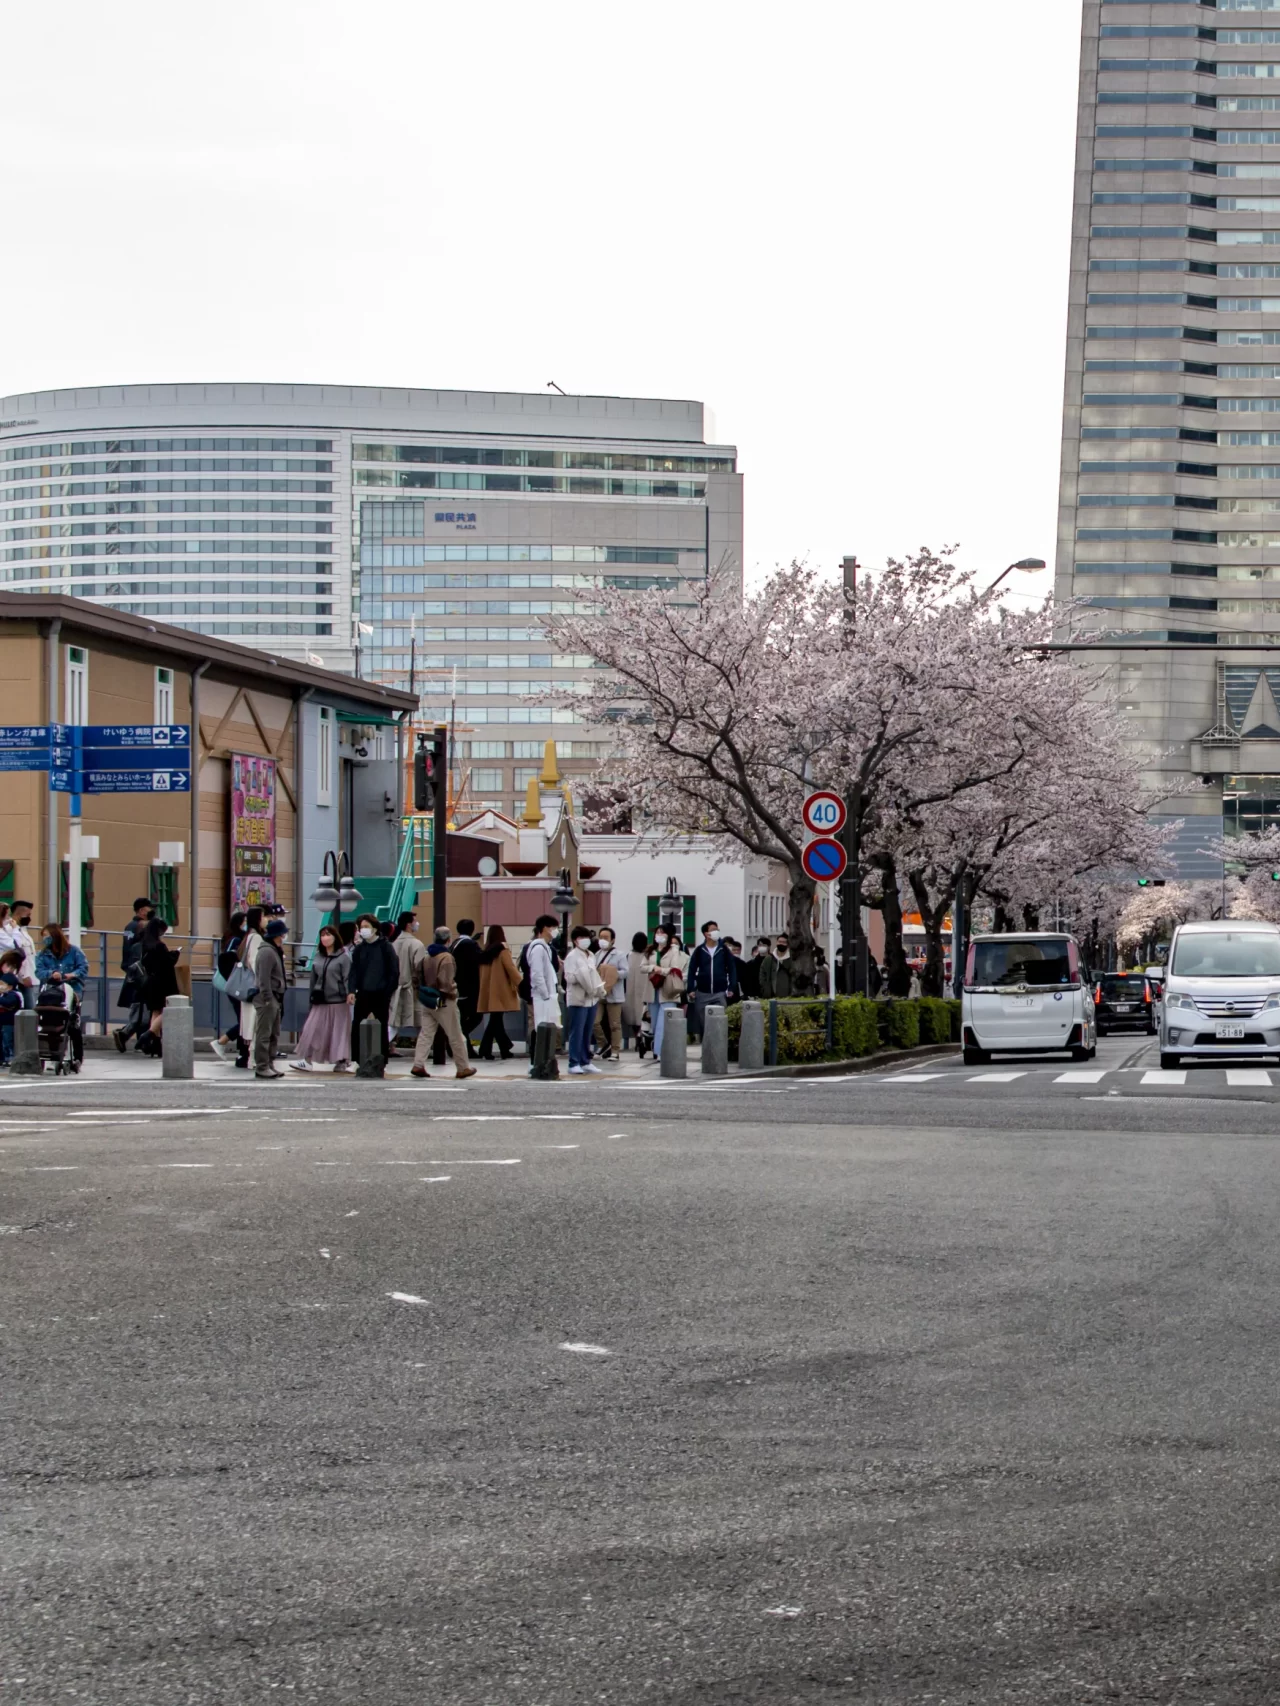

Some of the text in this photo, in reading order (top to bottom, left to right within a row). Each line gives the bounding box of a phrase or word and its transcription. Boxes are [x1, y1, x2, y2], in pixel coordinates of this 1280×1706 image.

[103, 728, 152, 736] けいゆう病院
[90, 773, 152, 782] 横浜みなとみらいホール
[812, 803, 836, 823] 40
